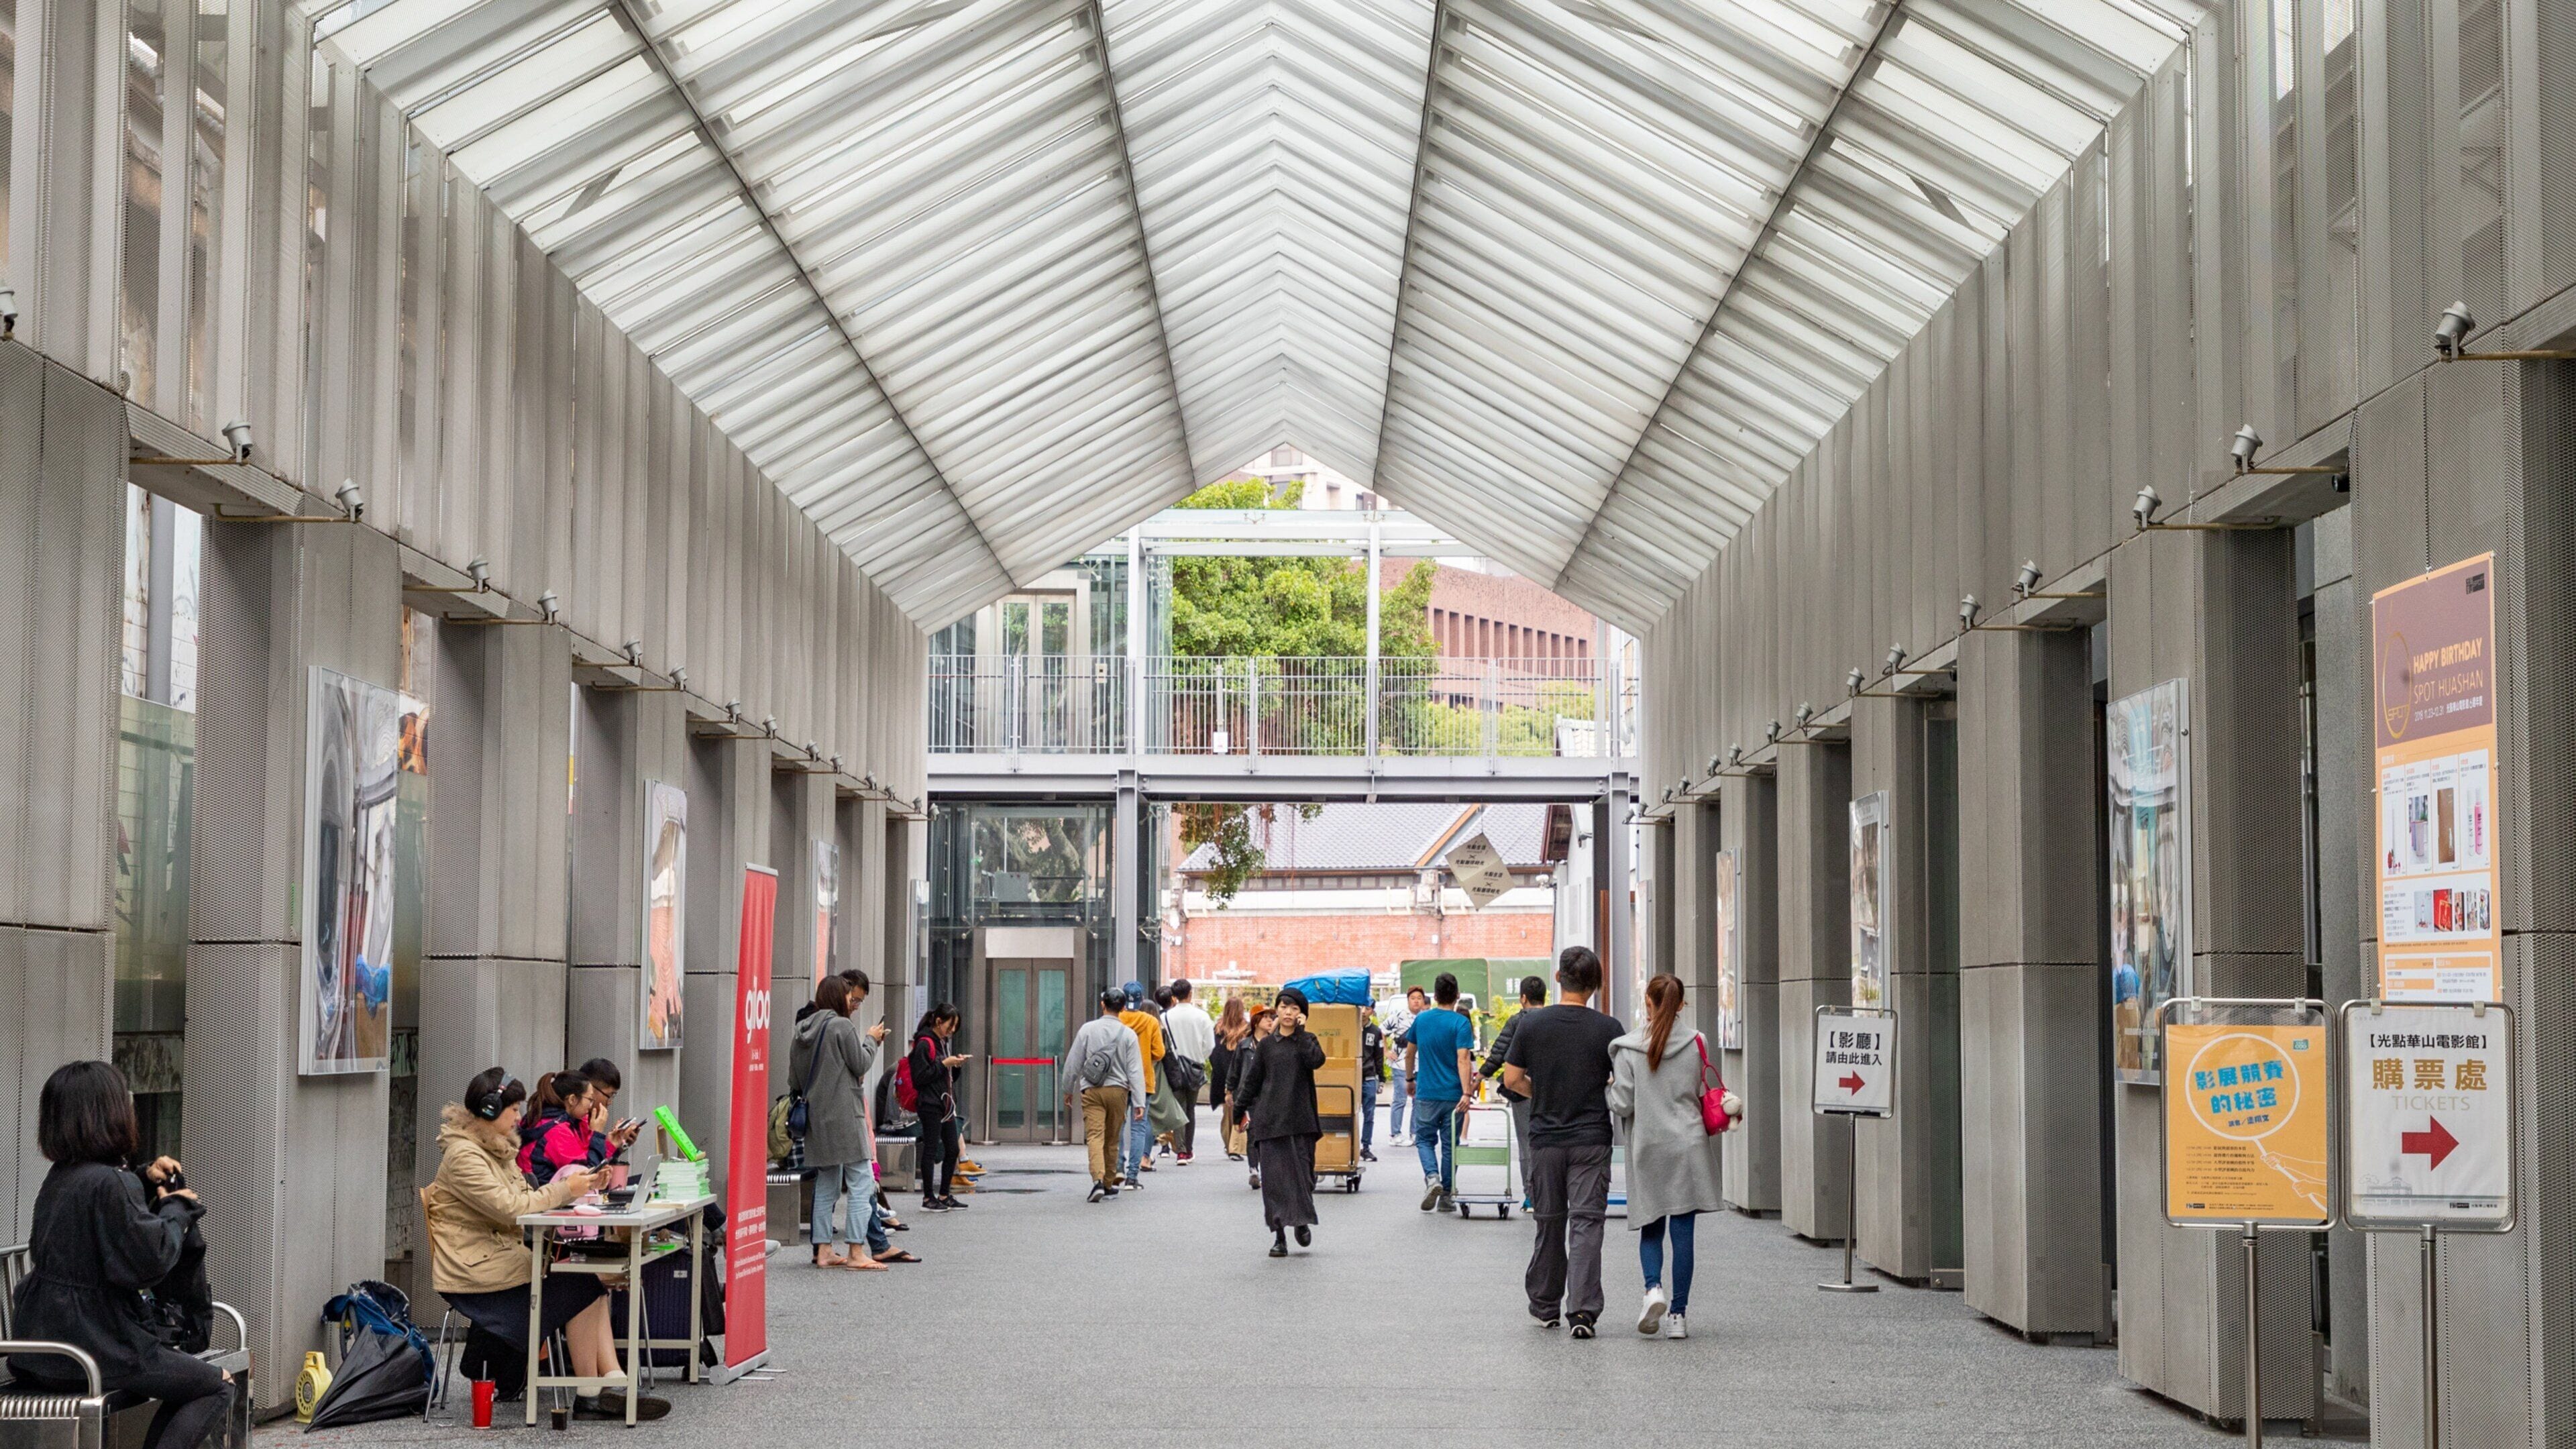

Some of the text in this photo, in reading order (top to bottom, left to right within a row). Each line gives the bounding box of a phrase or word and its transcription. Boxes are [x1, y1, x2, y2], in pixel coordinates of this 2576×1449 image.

[2413, 637, 2483, 674] HAPPY BIRTHDAY
[2414, 669, 2483, 704] SPOT HUASHAN
[1829, 1031, 1880, 1051] 【影廳】
[2369, 1034, 2487, 1049] 【光點華山電影館】
[1826, 1051, 1882, 1066] 請由此進入
[2195, 1061, 2284, 1091] 影展競賽
[2372, 1058, 2487, 1091] 購票處
[2210, 1087, 2277, 1114] 的秘密
[2392, 1095, 2471, 1111] TICKETS
